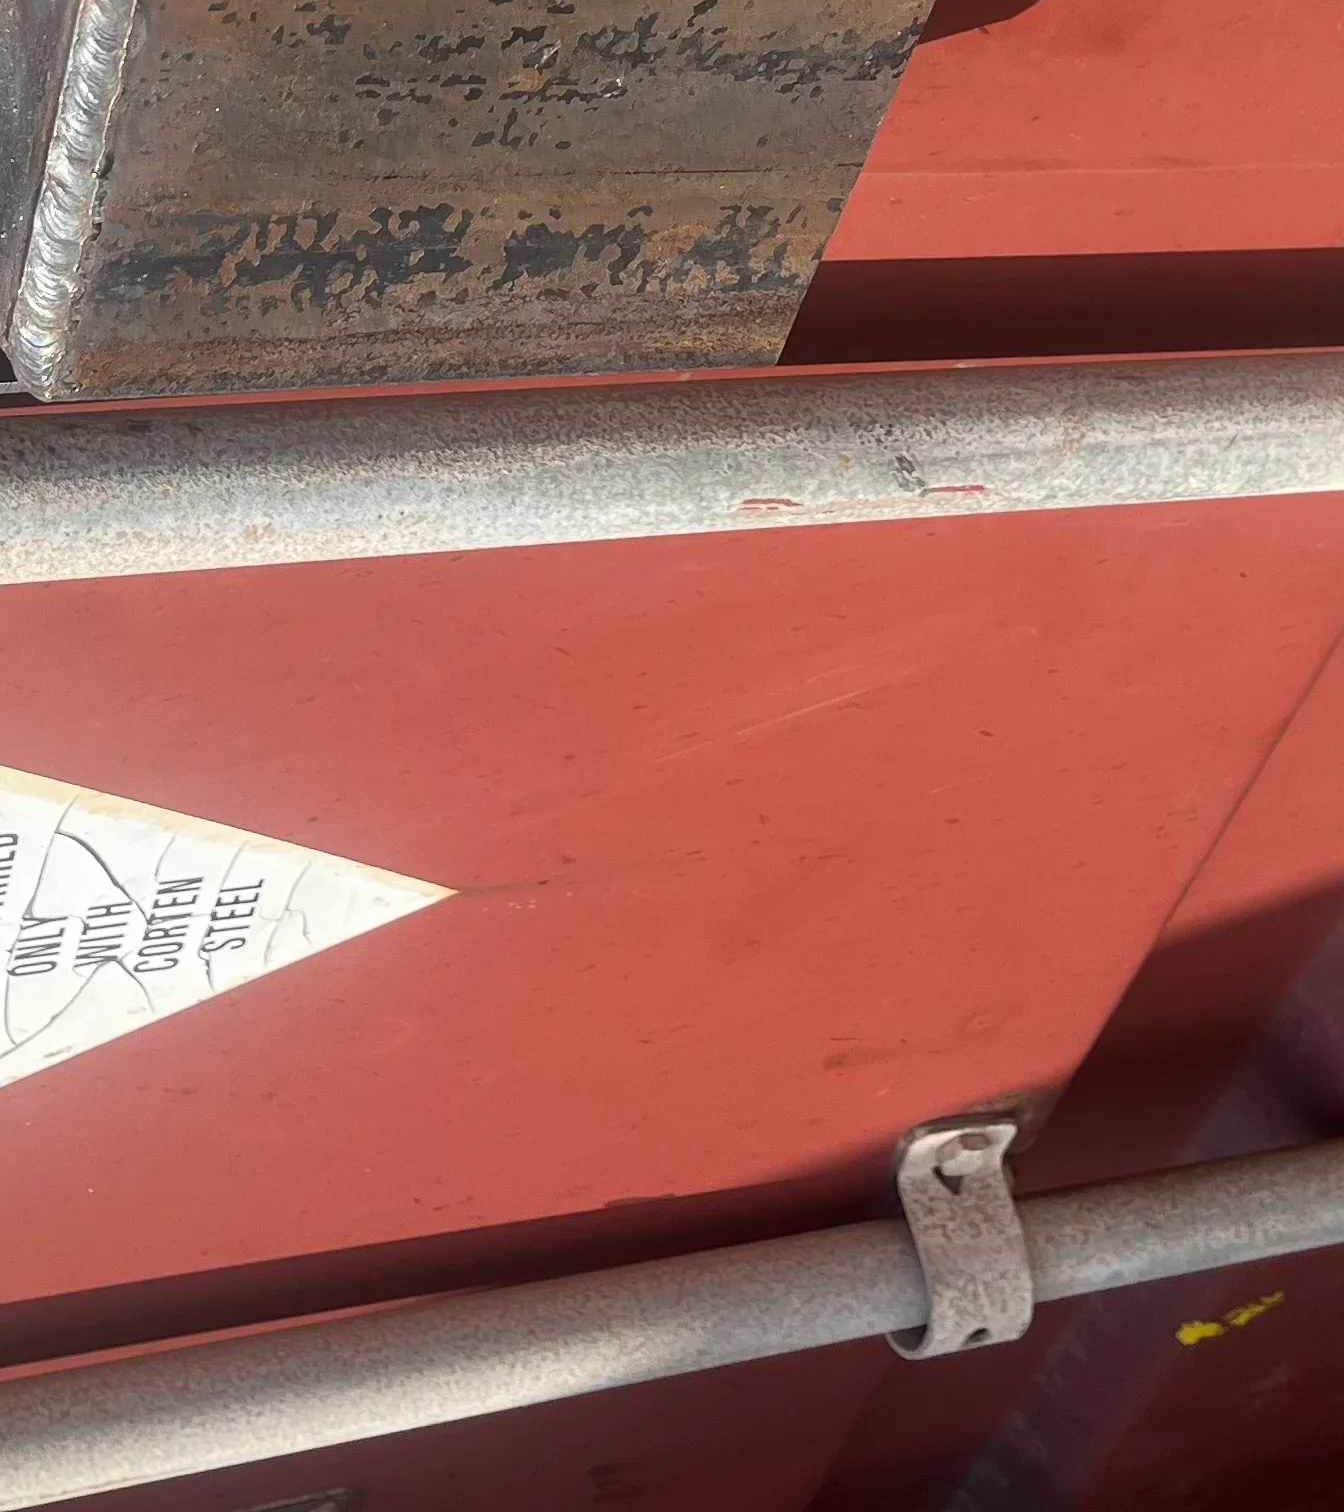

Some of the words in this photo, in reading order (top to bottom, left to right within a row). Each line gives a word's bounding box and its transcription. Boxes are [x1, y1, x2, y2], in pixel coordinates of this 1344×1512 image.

[10, 916, 68, 976] ONLY
[74, 901, 132, 967] WITH
[134, 877, 203, 973] CORTEN
[201, 879, 264, 953] STEEL
